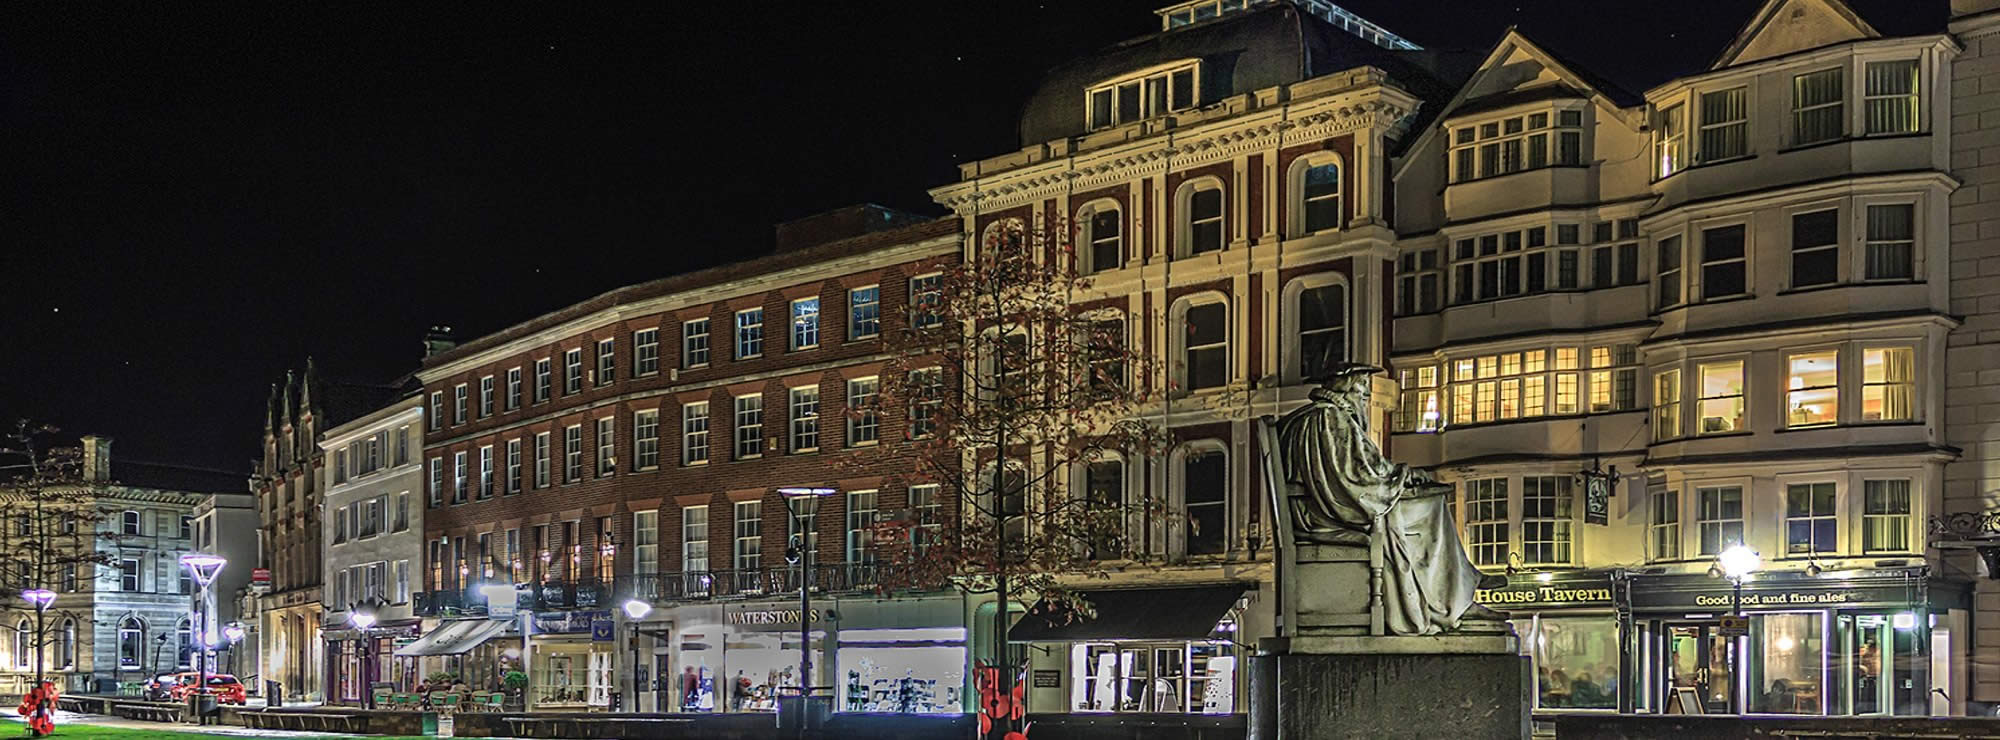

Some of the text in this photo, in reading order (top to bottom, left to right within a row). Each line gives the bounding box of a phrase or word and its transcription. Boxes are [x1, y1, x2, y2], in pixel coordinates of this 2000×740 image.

[1476, 587, 1611, 603] House Tavern
[1696, 595, 1729, 605] Good
[1762, 593, 1787, 604] and
[1790, 593, 1816, 603] fine
[1818, 592, 1846, 602] ales
[728, 610, 818, 624] WATERSTONS
